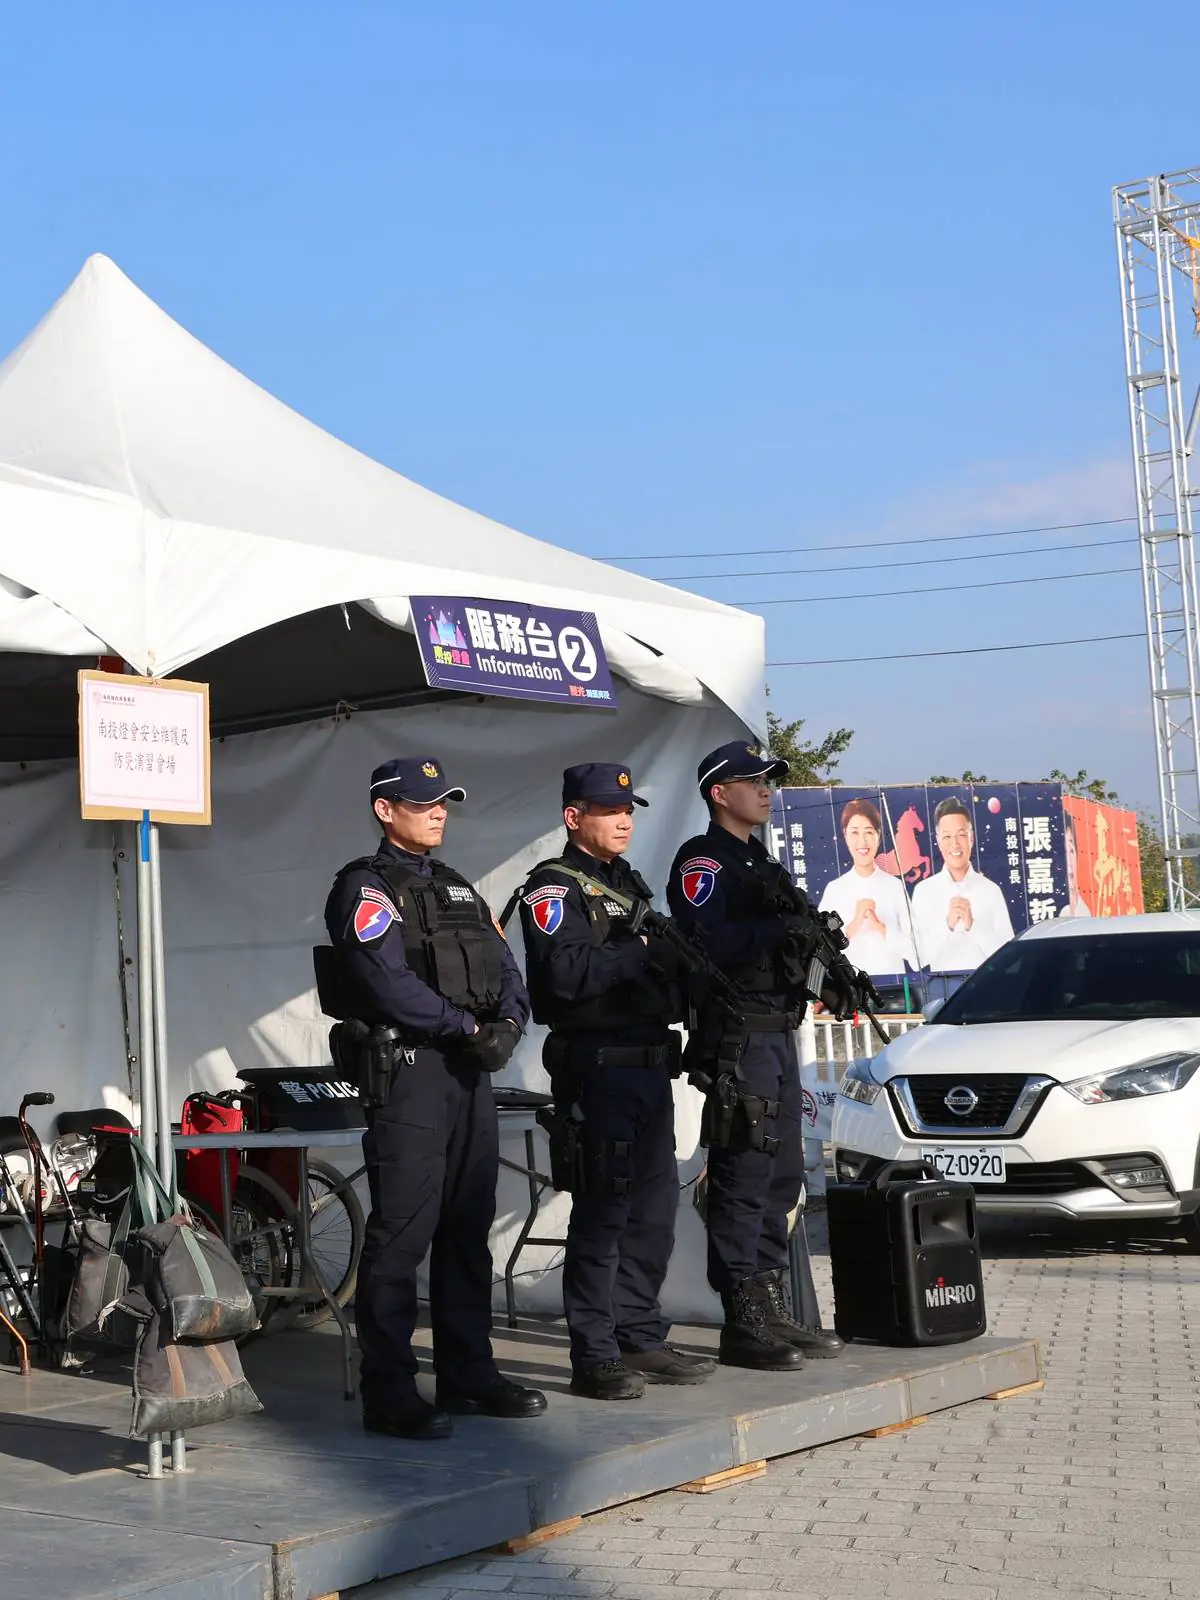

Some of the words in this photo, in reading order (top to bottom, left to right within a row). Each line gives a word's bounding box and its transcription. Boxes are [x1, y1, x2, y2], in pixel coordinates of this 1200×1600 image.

[465, 607, 557, 659] 服務台
[476, 652, 563, 682] Information
[790, 823, 808, 892] 南投縣長
[1005, 817, 1021, 884] 南投市長
[304, 1081, 360, 1099] POLIC
